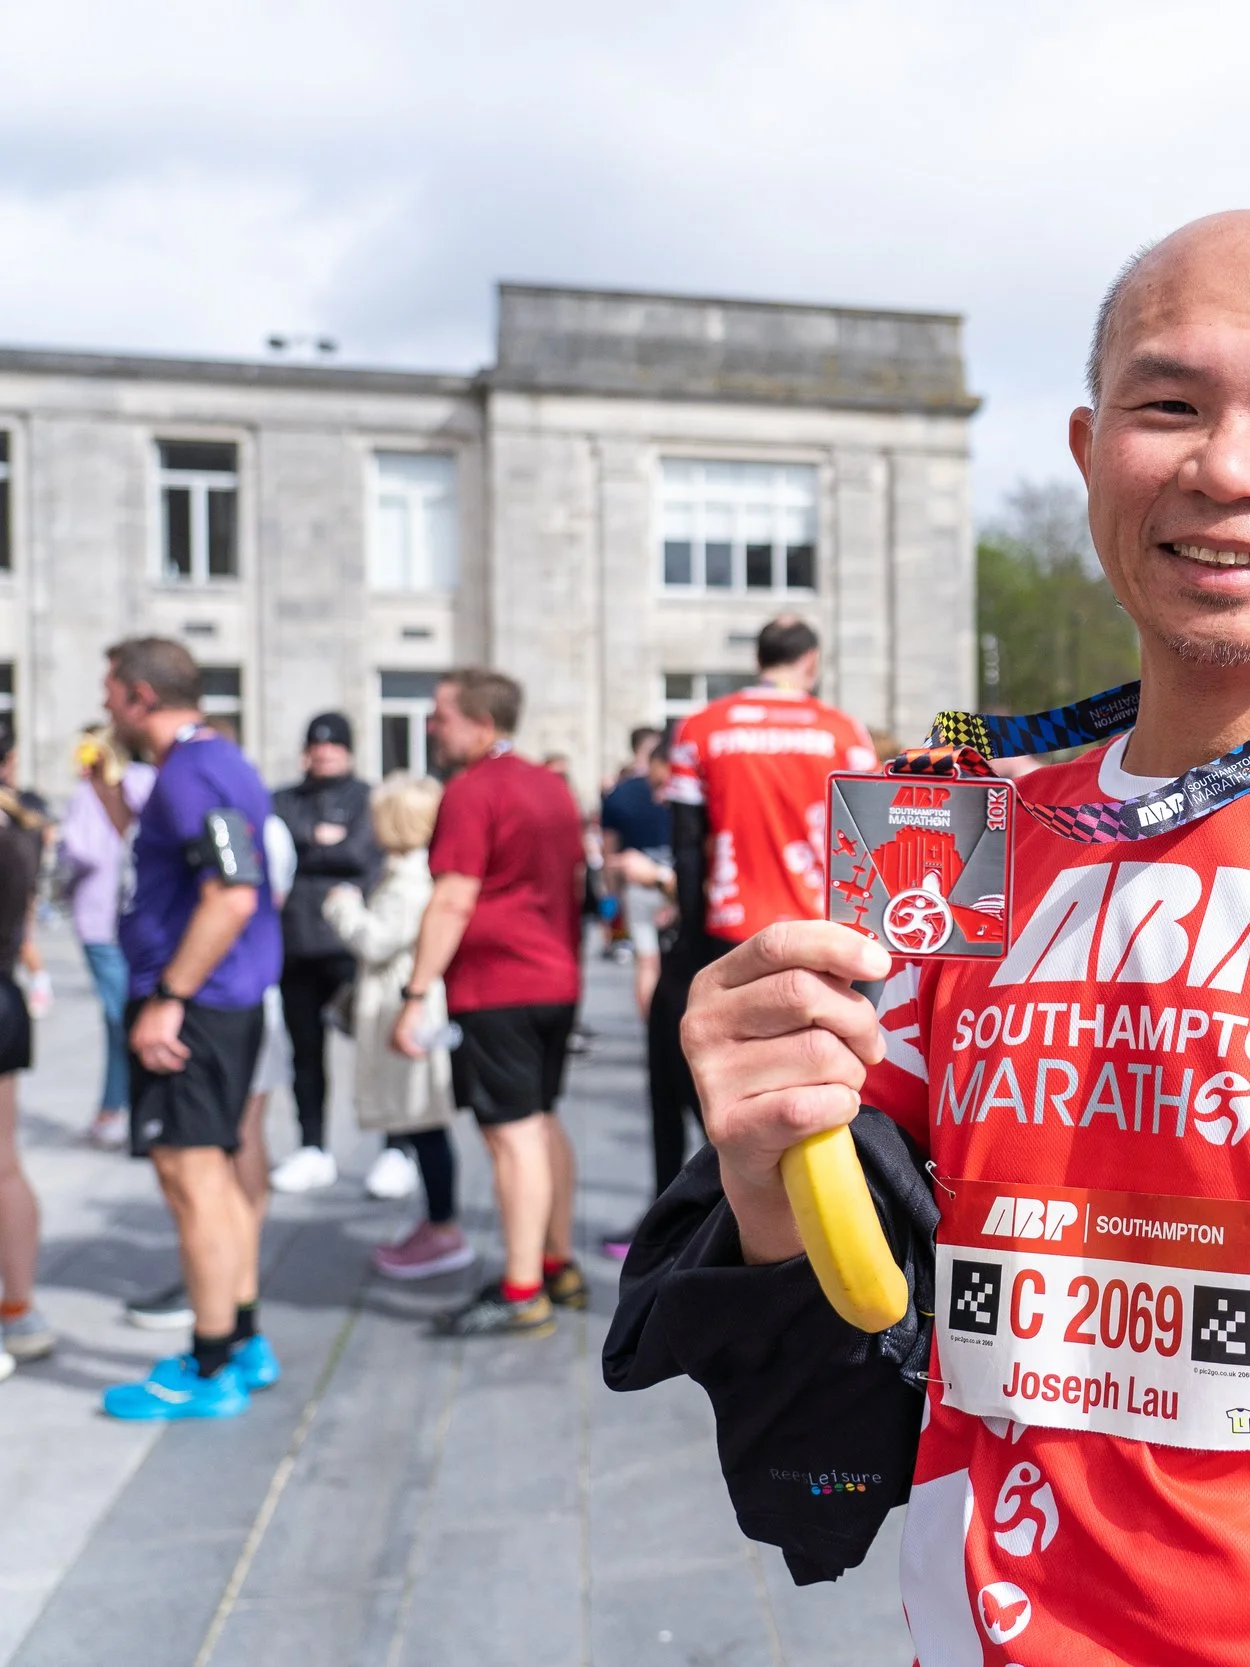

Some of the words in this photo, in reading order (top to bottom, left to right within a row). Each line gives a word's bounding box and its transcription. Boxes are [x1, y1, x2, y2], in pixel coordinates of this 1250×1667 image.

[1089, 694, 1139, 720] RATHON
[1094, 705, 1138, 729] HAMPTON
[891, 786, 951, 808] ABP
[987, 788, 1008, 831] 10K
[1137, 792, 1185, 827] ABP
[888, 807, 951, 817] SOUTHAMPTON
[888, 815, 951, 827] MARATHON
[981, 1196, 1079, 1242] ABP
[1096, 1216, 1224, 1245] SOUTHAMPTON
[1010, 1269, 1046, 1339] C
[1063, 1275, 1184, 1358] 2069
[1199, 1368, 1237, 1377] pic2go.co.uk
[1003, 1361, 1120, 1414] Joseph
[1127, 1375, 1179, 1420] Lau
